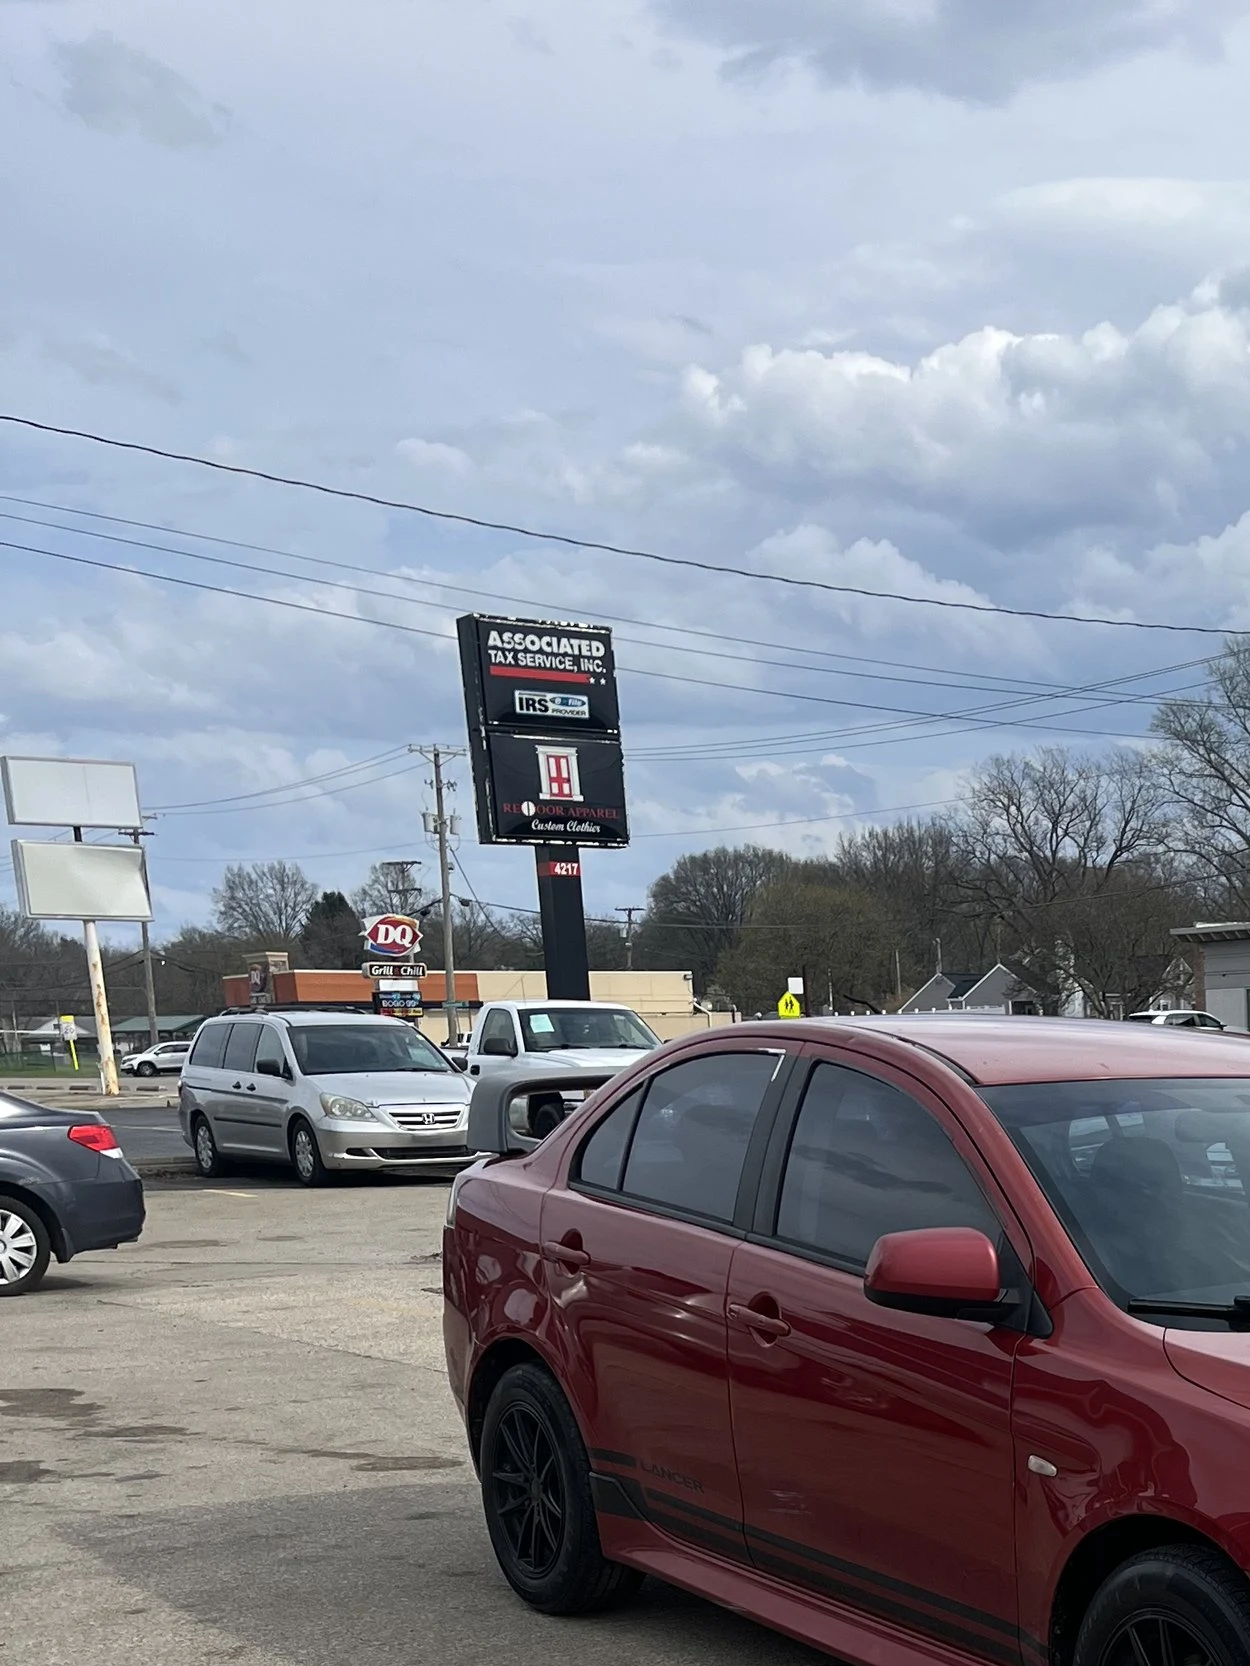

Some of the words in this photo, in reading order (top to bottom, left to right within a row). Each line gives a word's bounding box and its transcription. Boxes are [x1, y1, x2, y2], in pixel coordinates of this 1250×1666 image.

[487, 630, 606, 658] ASSOCIATED
[488, 649, 515, 665] TAX
[518, 653, 578, 673] SERVICE,
[580, 658, 607, 674] INC.
[518, 696, 549, 713] IRS
[551, 708, 587, 717] PROVIDER
[568, 805, 620, 819] APPAREL
[531, 818, 565, 832] Custom
[566, 819, 601, 833] Clothier
[554, 862, 579, 875] 4217
[376, 924, 413, 947] DQ
[371, 965, 394, 975] Grill
[400, 966, 423, 976] Chill
[641, 1459, 704, 1494] LANCER
